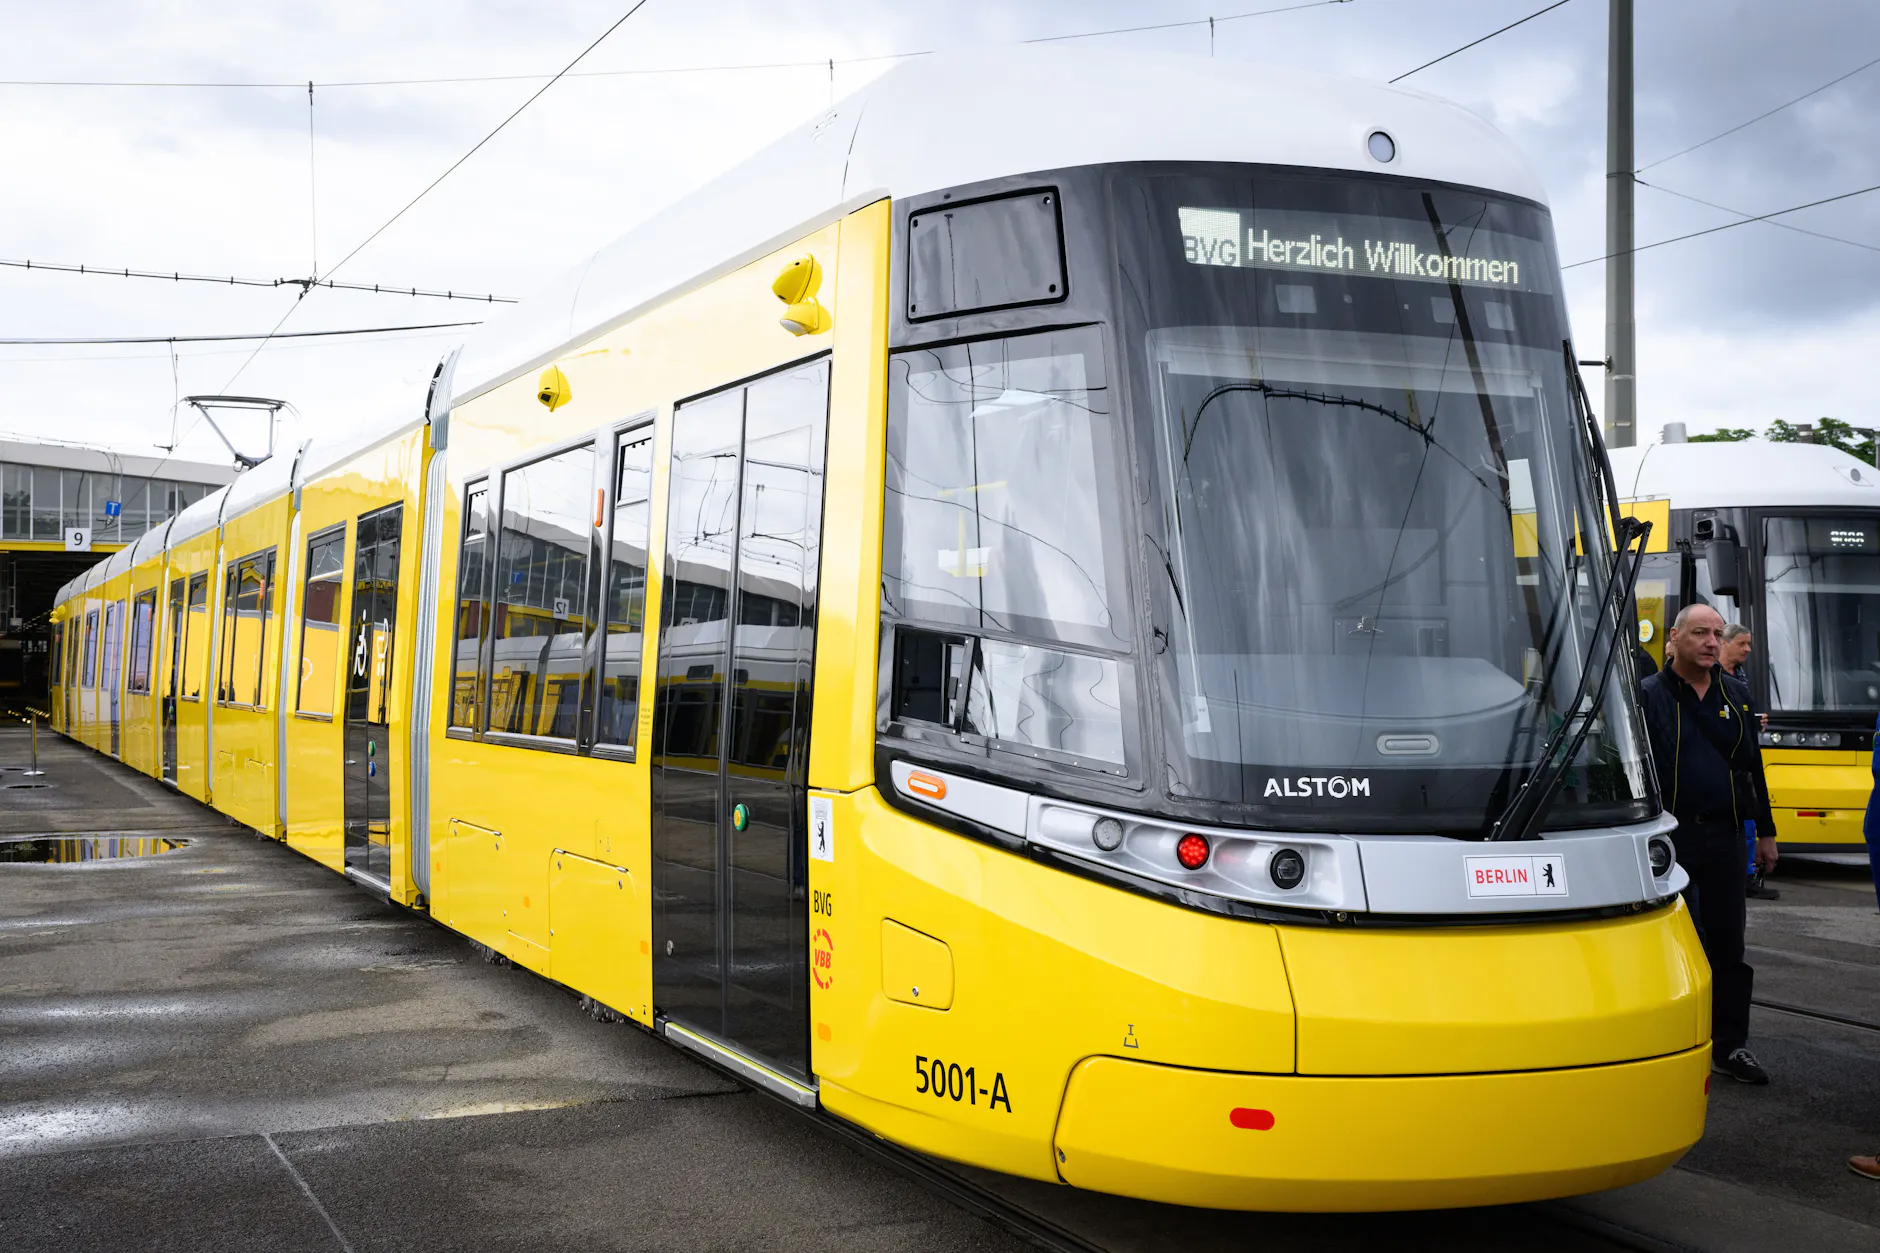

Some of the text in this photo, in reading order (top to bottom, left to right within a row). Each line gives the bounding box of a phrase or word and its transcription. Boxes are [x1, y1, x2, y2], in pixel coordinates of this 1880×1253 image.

[1183, 235, 1238, 266] BVG
[1248, 228, 1519, 284] Herzlich Willkommen
[74, 532, 83, 546] 9
[1263, 775, 1371, 799] ALSTOM
[1475, 868, 1528, 885] BERLIN
[813, 889, 832, 917] BVG
[814, 948, 832, 969] VBB
[915, 1055, 1012, 1113] 5001-A
